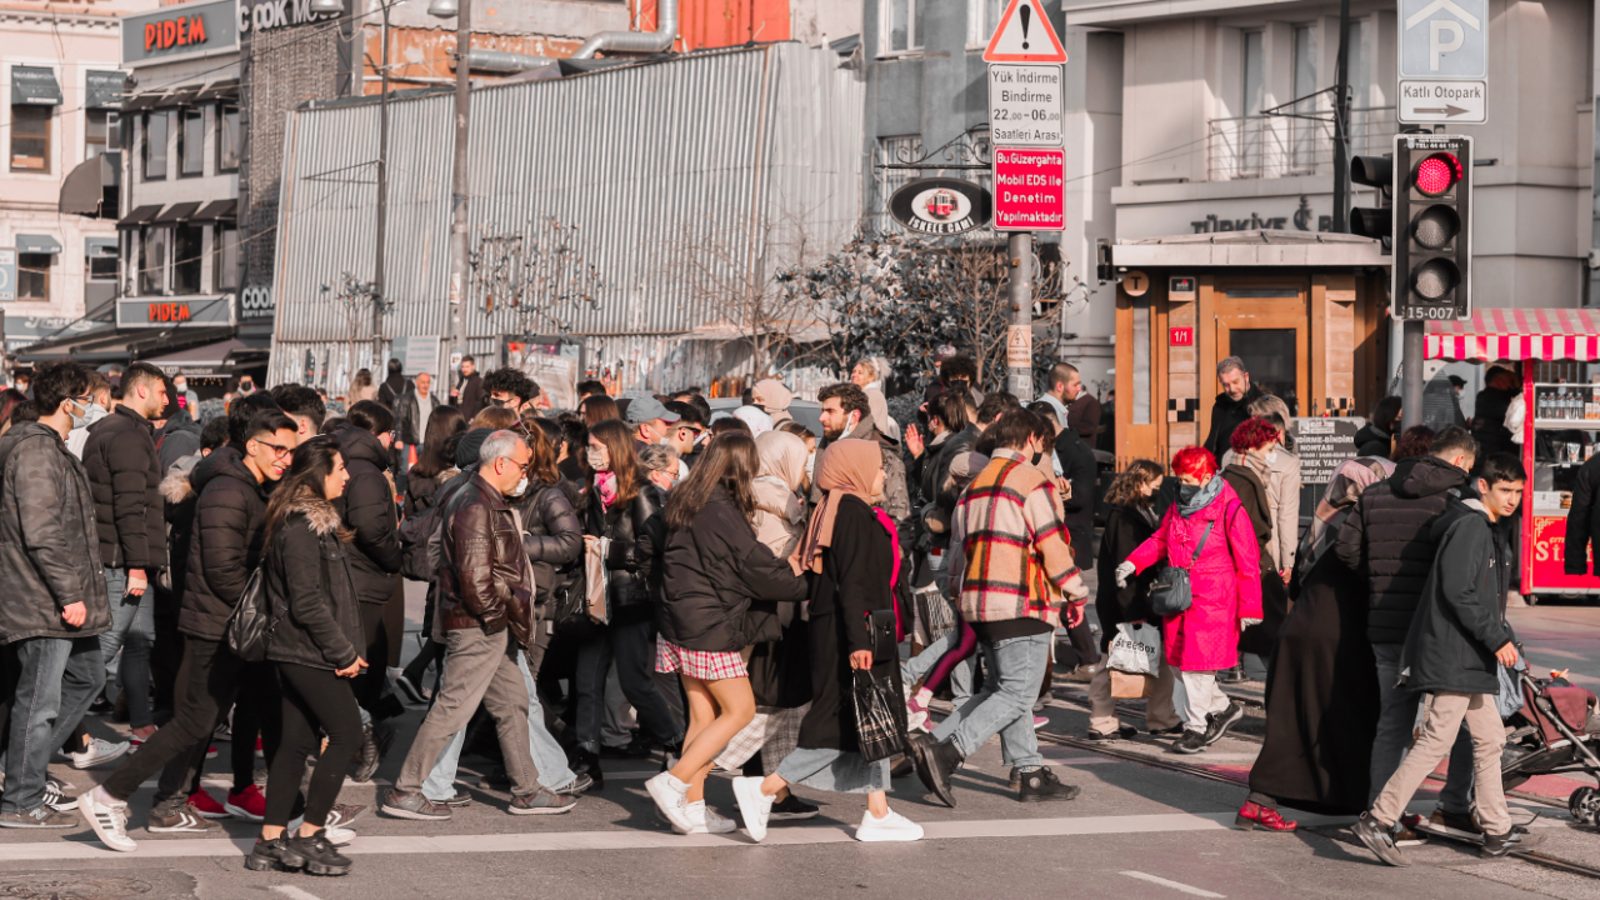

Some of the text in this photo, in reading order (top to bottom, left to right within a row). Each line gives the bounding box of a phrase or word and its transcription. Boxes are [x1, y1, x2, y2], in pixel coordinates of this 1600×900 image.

[1429, 20, 1465, 71] P
[992, 70, 1013, 83] Yük
[1002, 88, 1052, 102] Bindirme
[1403, 86, 1481, 101] Katlı Otopark
[994, 128, 1060, 141] Saatleri Arası
[997, 152, 1062, 167] Bu Güzergahta
[997, 174, 1025, 185] Mobil
[1026, 174, 1047, 186] EDS
[1004, 191, 1056, 203] Denetim
[997, 210, 1063, 225] Yapılmaktadır
[1131, 276, 1142, 290] T
[1174, 330, 1188, 343] 1/1
